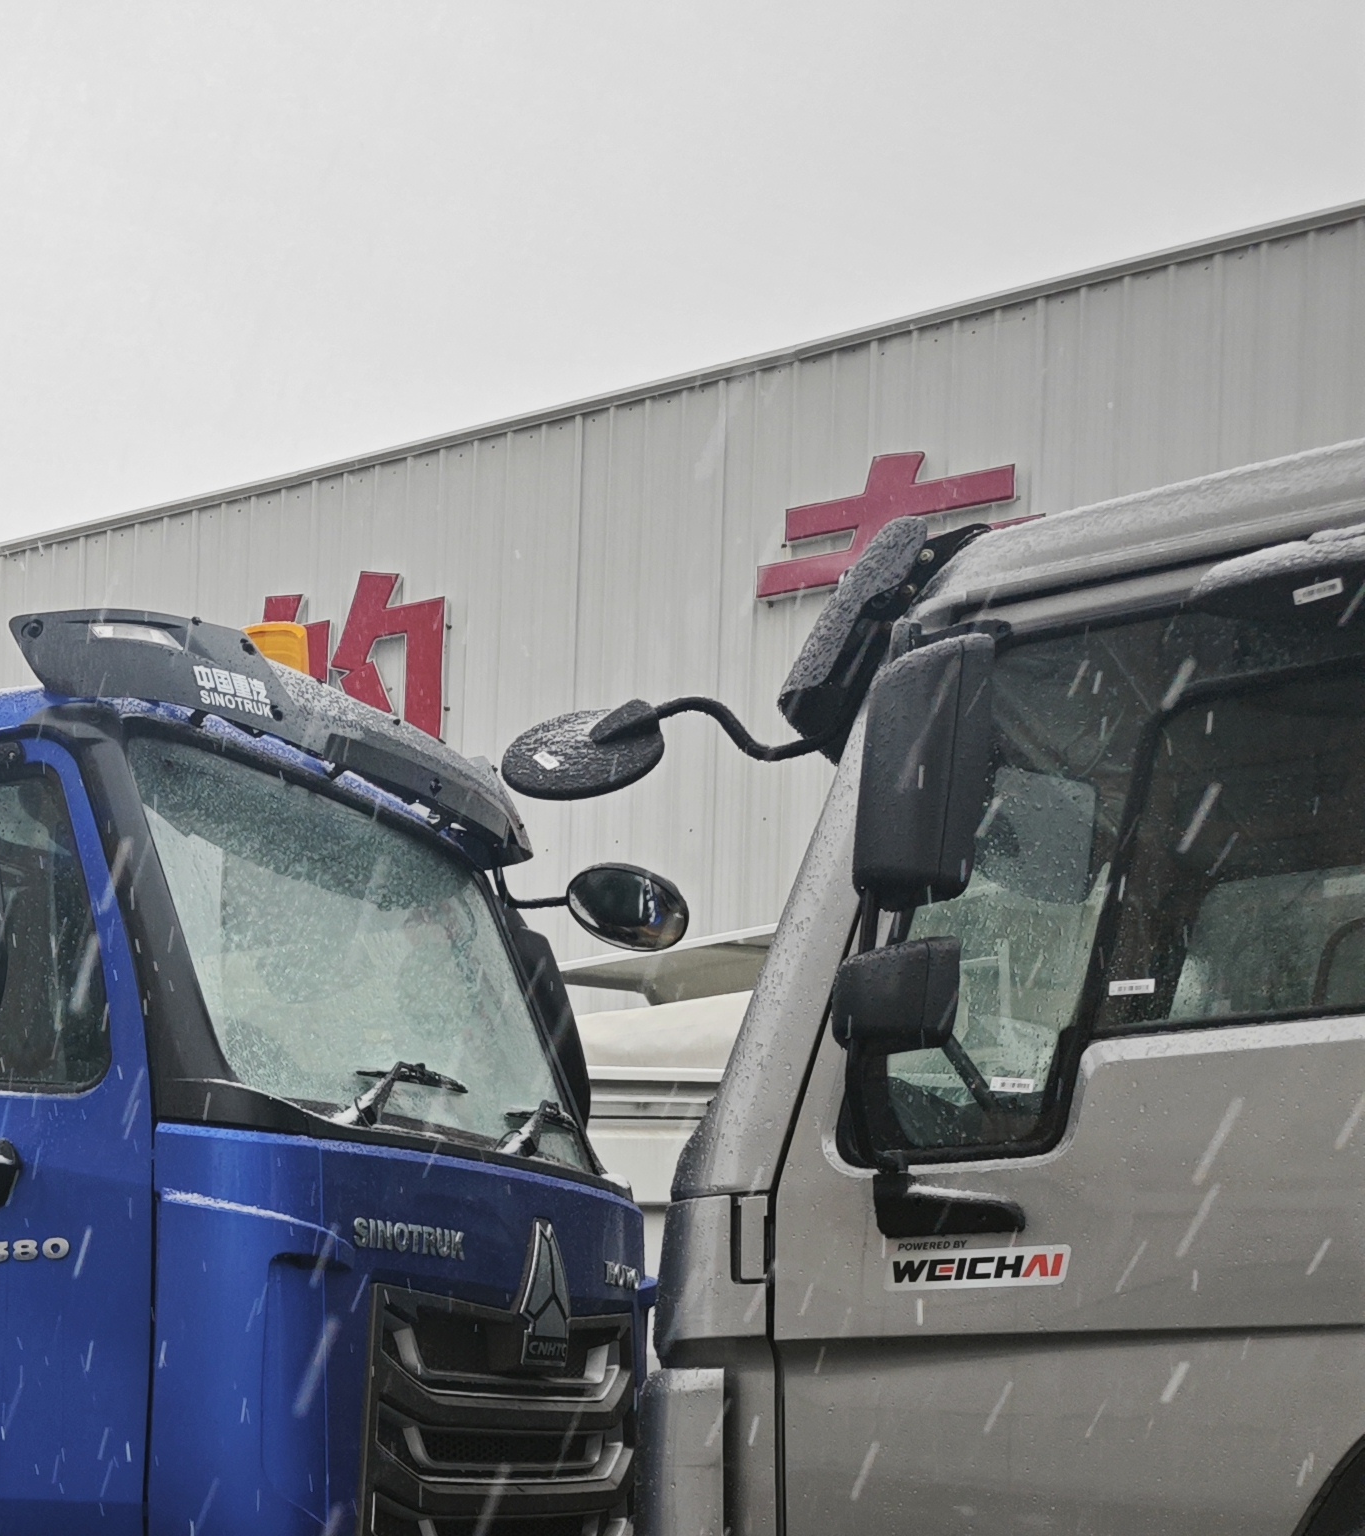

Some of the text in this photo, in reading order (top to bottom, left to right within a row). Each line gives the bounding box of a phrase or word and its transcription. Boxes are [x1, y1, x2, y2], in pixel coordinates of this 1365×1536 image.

[193, 665, 271, 704] 中国重汽
[200, 689, 273, 719] SINOTRUK
[353, 1216, 466, 1261] SINOTRUK
[897, 1239, 968, 1252] POWERED BY
[892, 1253, 1065, 1284] WEICHAI
